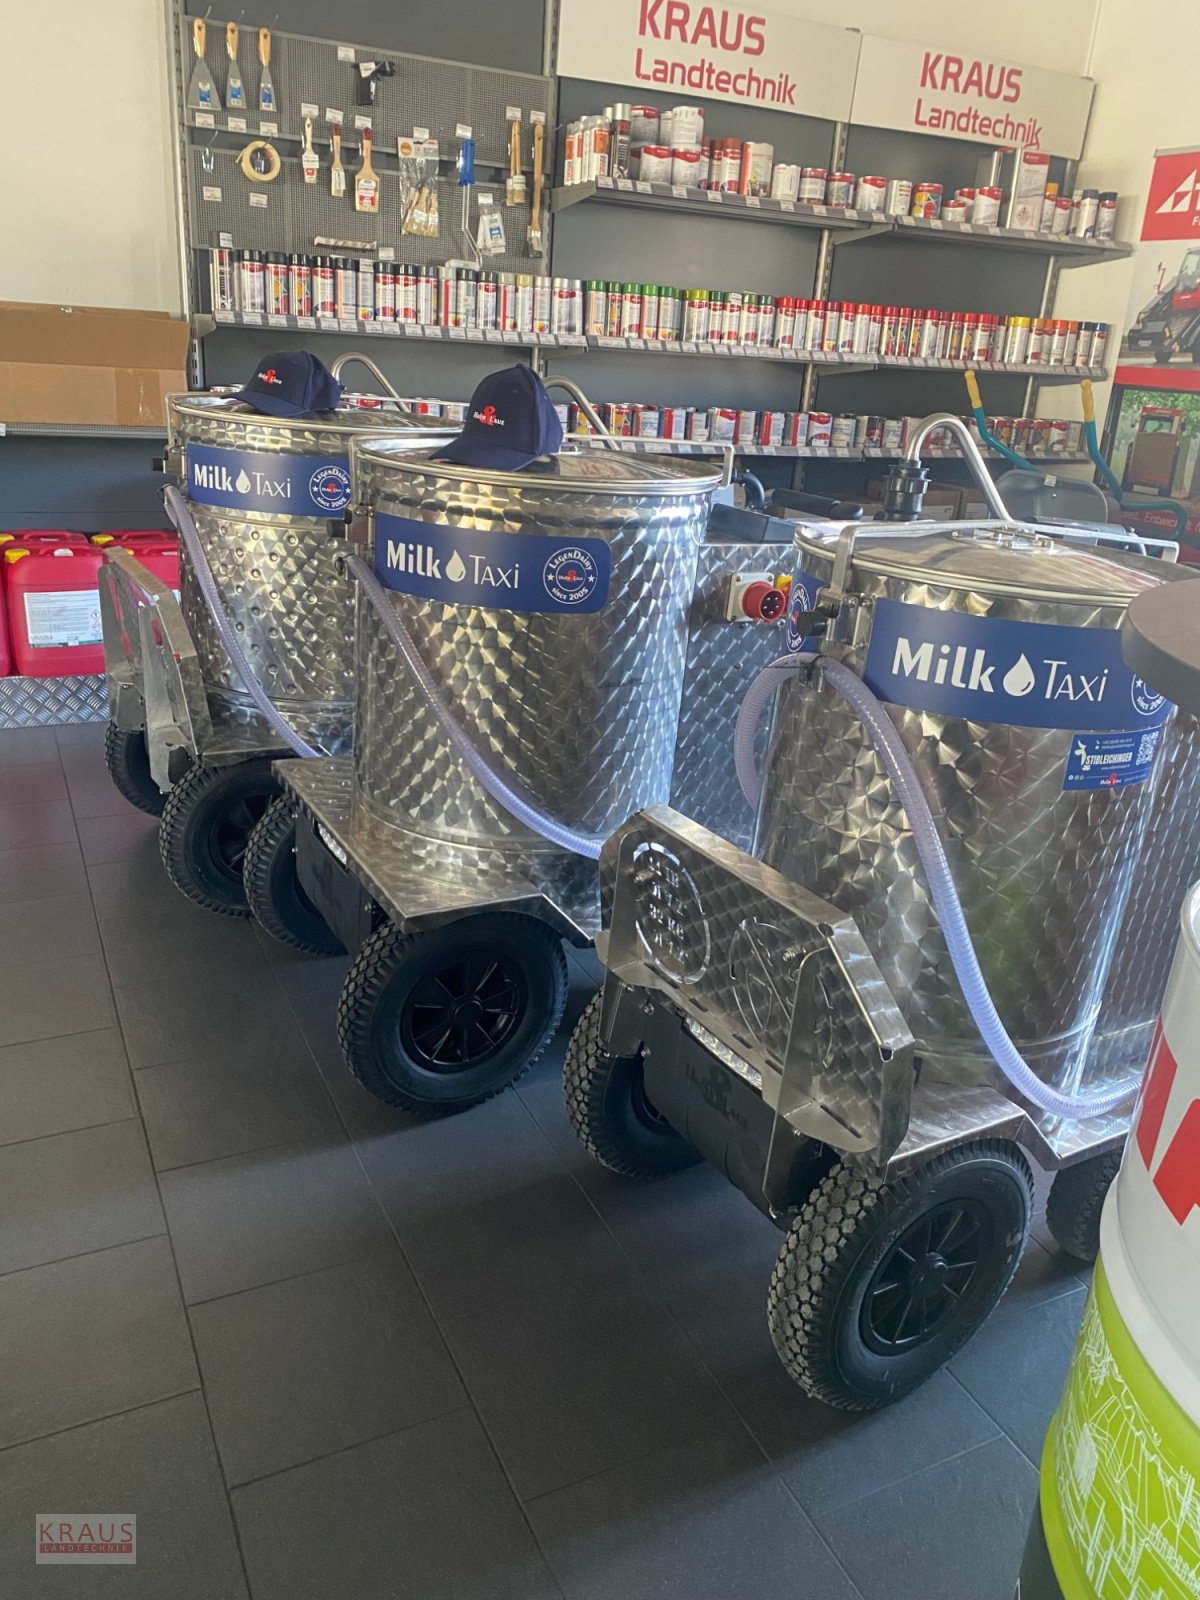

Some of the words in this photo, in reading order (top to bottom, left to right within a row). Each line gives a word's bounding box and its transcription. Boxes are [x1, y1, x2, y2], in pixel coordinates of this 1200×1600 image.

[638, 0, 766, 56] KRAUS
[635, 48, 797, 105] Landtechnik
[920, 52, 1022, 103] KRAUS
[915, 98, 1042, 144] Landtechnik
[194, 463, 234, 492] Milk
[387, 539, 442, 579] Milk
[568, 586, 589, 601] 2005
[892, 637, 996, 693] Milk
